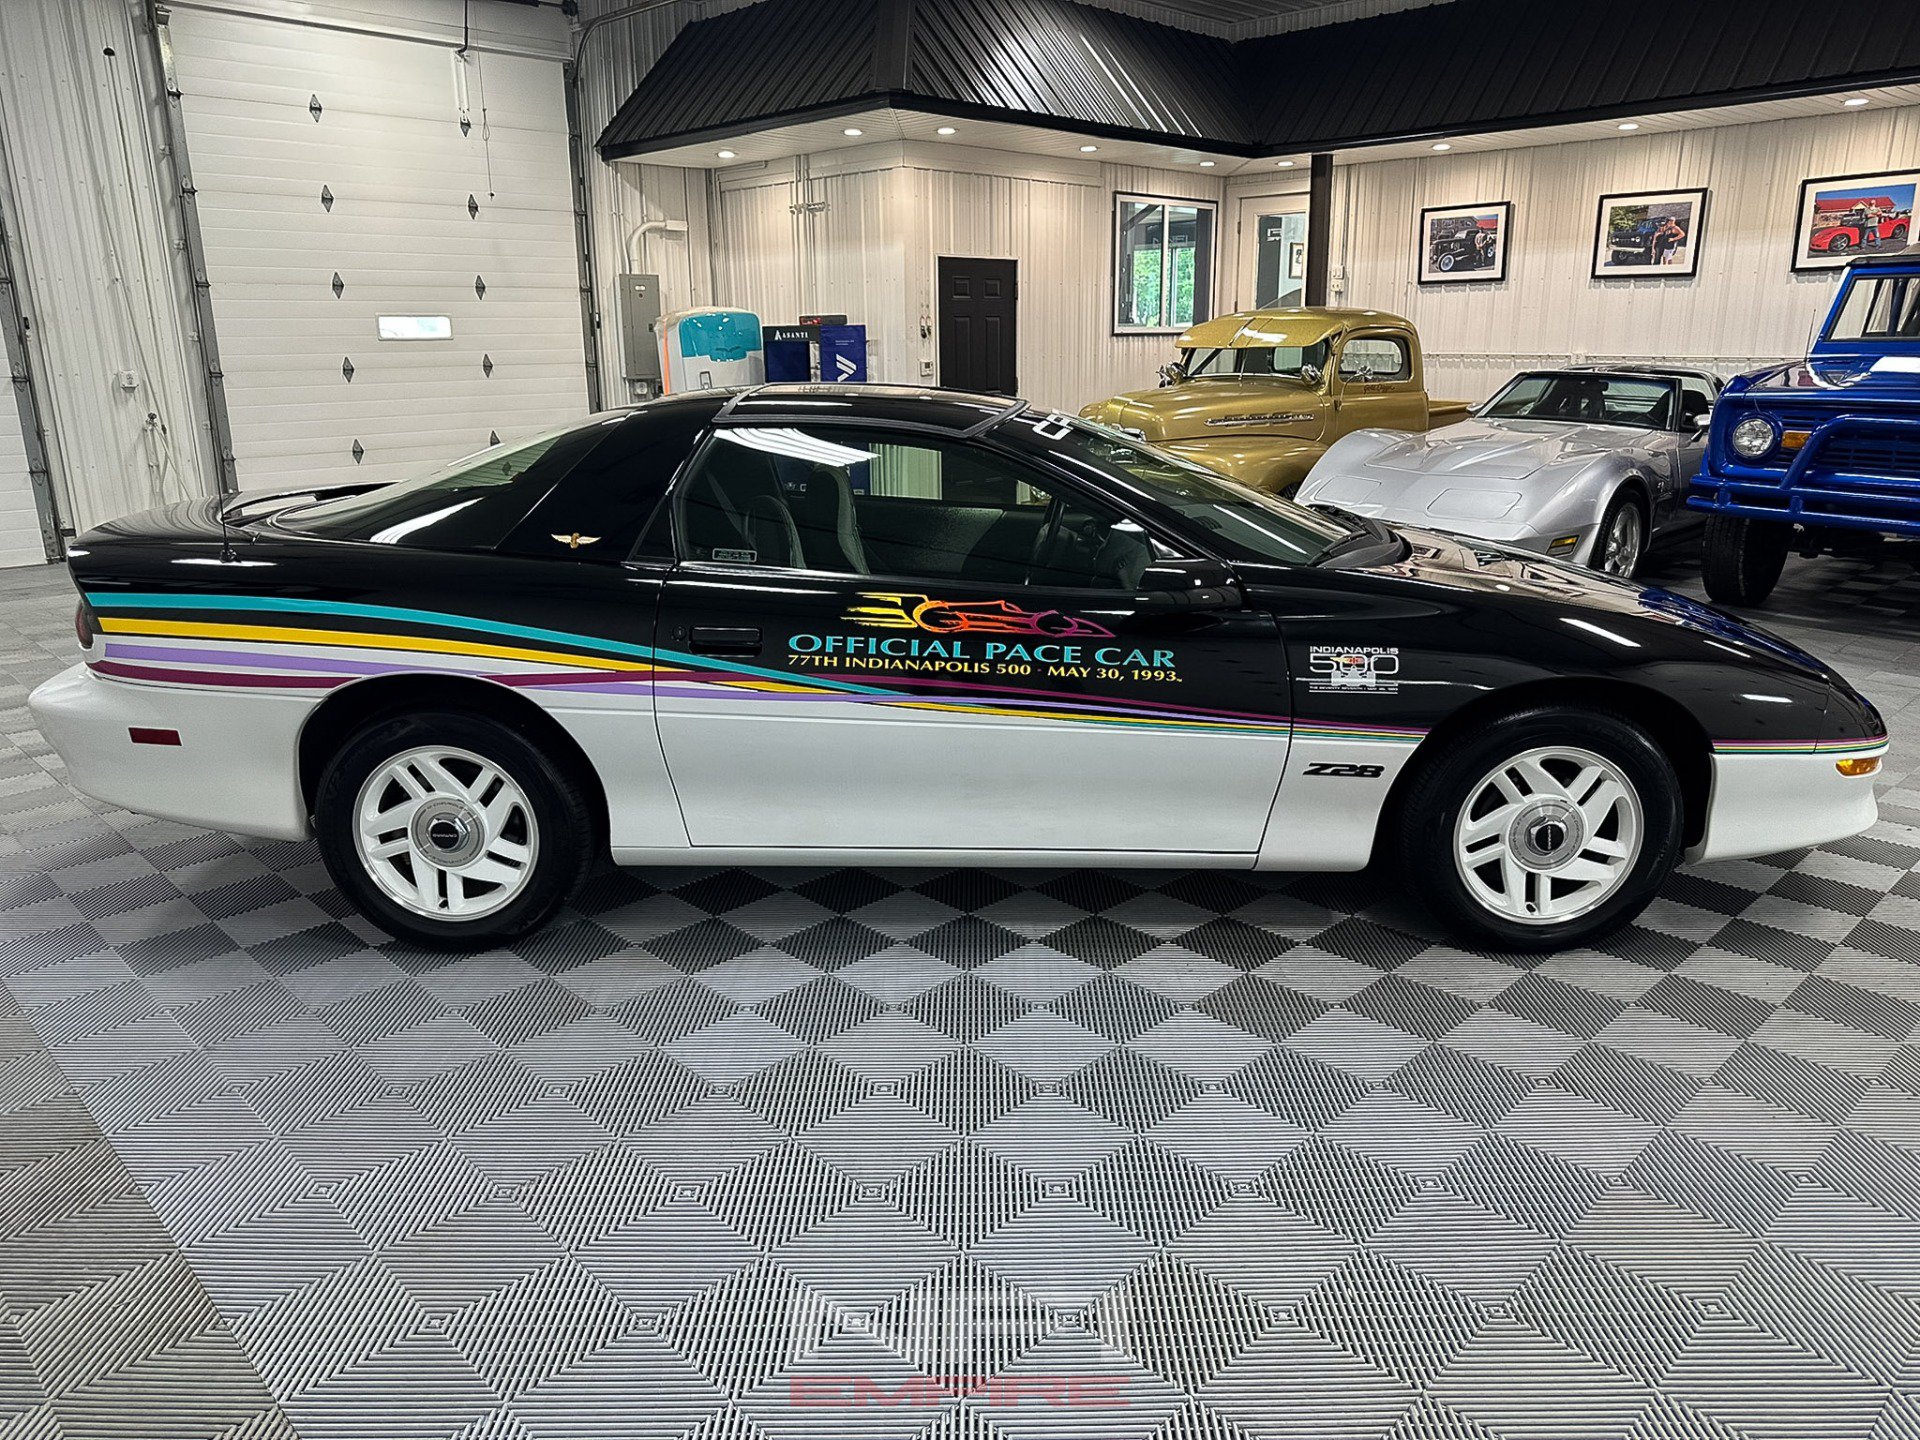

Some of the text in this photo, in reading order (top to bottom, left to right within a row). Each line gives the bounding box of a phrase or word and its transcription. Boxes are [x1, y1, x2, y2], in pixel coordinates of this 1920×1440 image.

[788, 634, 1176, 668] OFFICIAL PACE CAR
[1309, 646, 1399, 655] INDIANAPOLIS
[788, 655, 838, 667] 77TH
[845, 657, 990, 674] INDIANAPOLIS
[996, 663, 1031, 675] 500
[1047, 665, 1091, 678] MAY
[1096, 667, 1125, 681] 30,
[1309, 653, 1399, 675] 500
[1303, 763, 1385, 778] Z28
